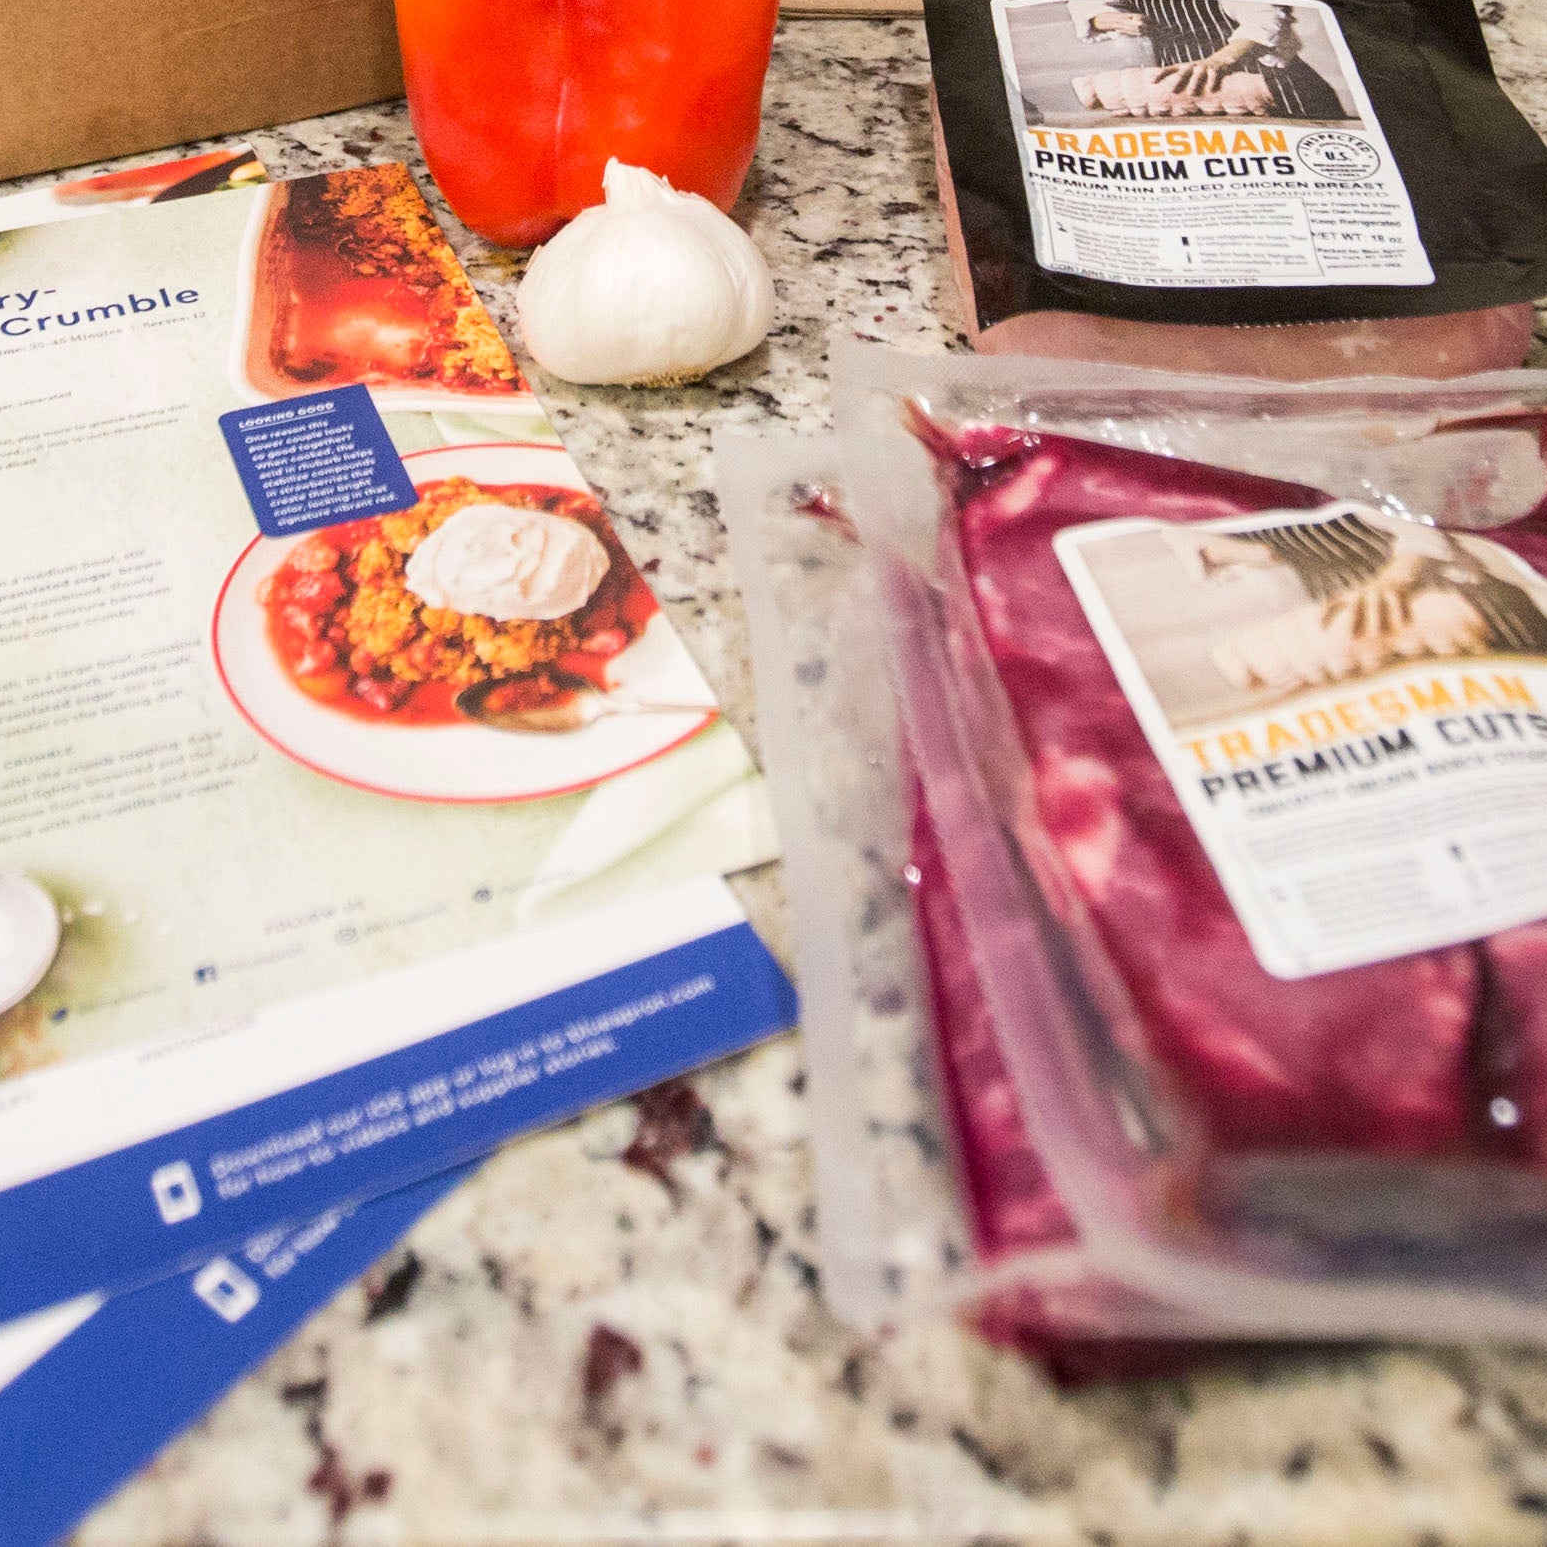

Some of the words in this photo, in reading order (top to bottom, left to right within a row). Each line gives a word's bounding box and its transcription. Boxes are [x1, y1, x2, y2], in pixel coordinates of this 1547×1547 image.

[1027, 129, 1289, 159] TRADESMAN
[1301, 133, 1371, 153] INSPECTED
[1324, 151, 1353, 162] U.S.
[1034, 149, 1189, 181] PREMIUM
[1205, 155, 1296, 179] CUTS
[1028, 171, 1109, 192] PREMIUM
[1114, 184, 1154, 194] THIN
[1160, 182, 1224, 194] SLICED
[1230, 181, 1308, 190] CHICKEN
[1313, 181, 1386, 190] BREAST
[1187, 192, 1237, 201] EVER
[1245, 190, 1390, 198] ADMINISTERED
[1340, 219, 1401, 227] Refrigerated
[0, 286, 200, 336] Crumble
[239, 409, 295, 428] LOOKING
[298, 402, 334, 416] GOOD
[1187, 672, 1540, 774] TRADESMAN
[1199, 728, 1418, 805] PREMIUM
[210, 1118, 324, 1179] Download
[325, 1107, 364, 1136] our
[454, 1064, 475, 1088] or
[477, 1048, 517, 1077] log
[540, 1031, 566, 1053] to
[414, 1093, 456, 1128] and
